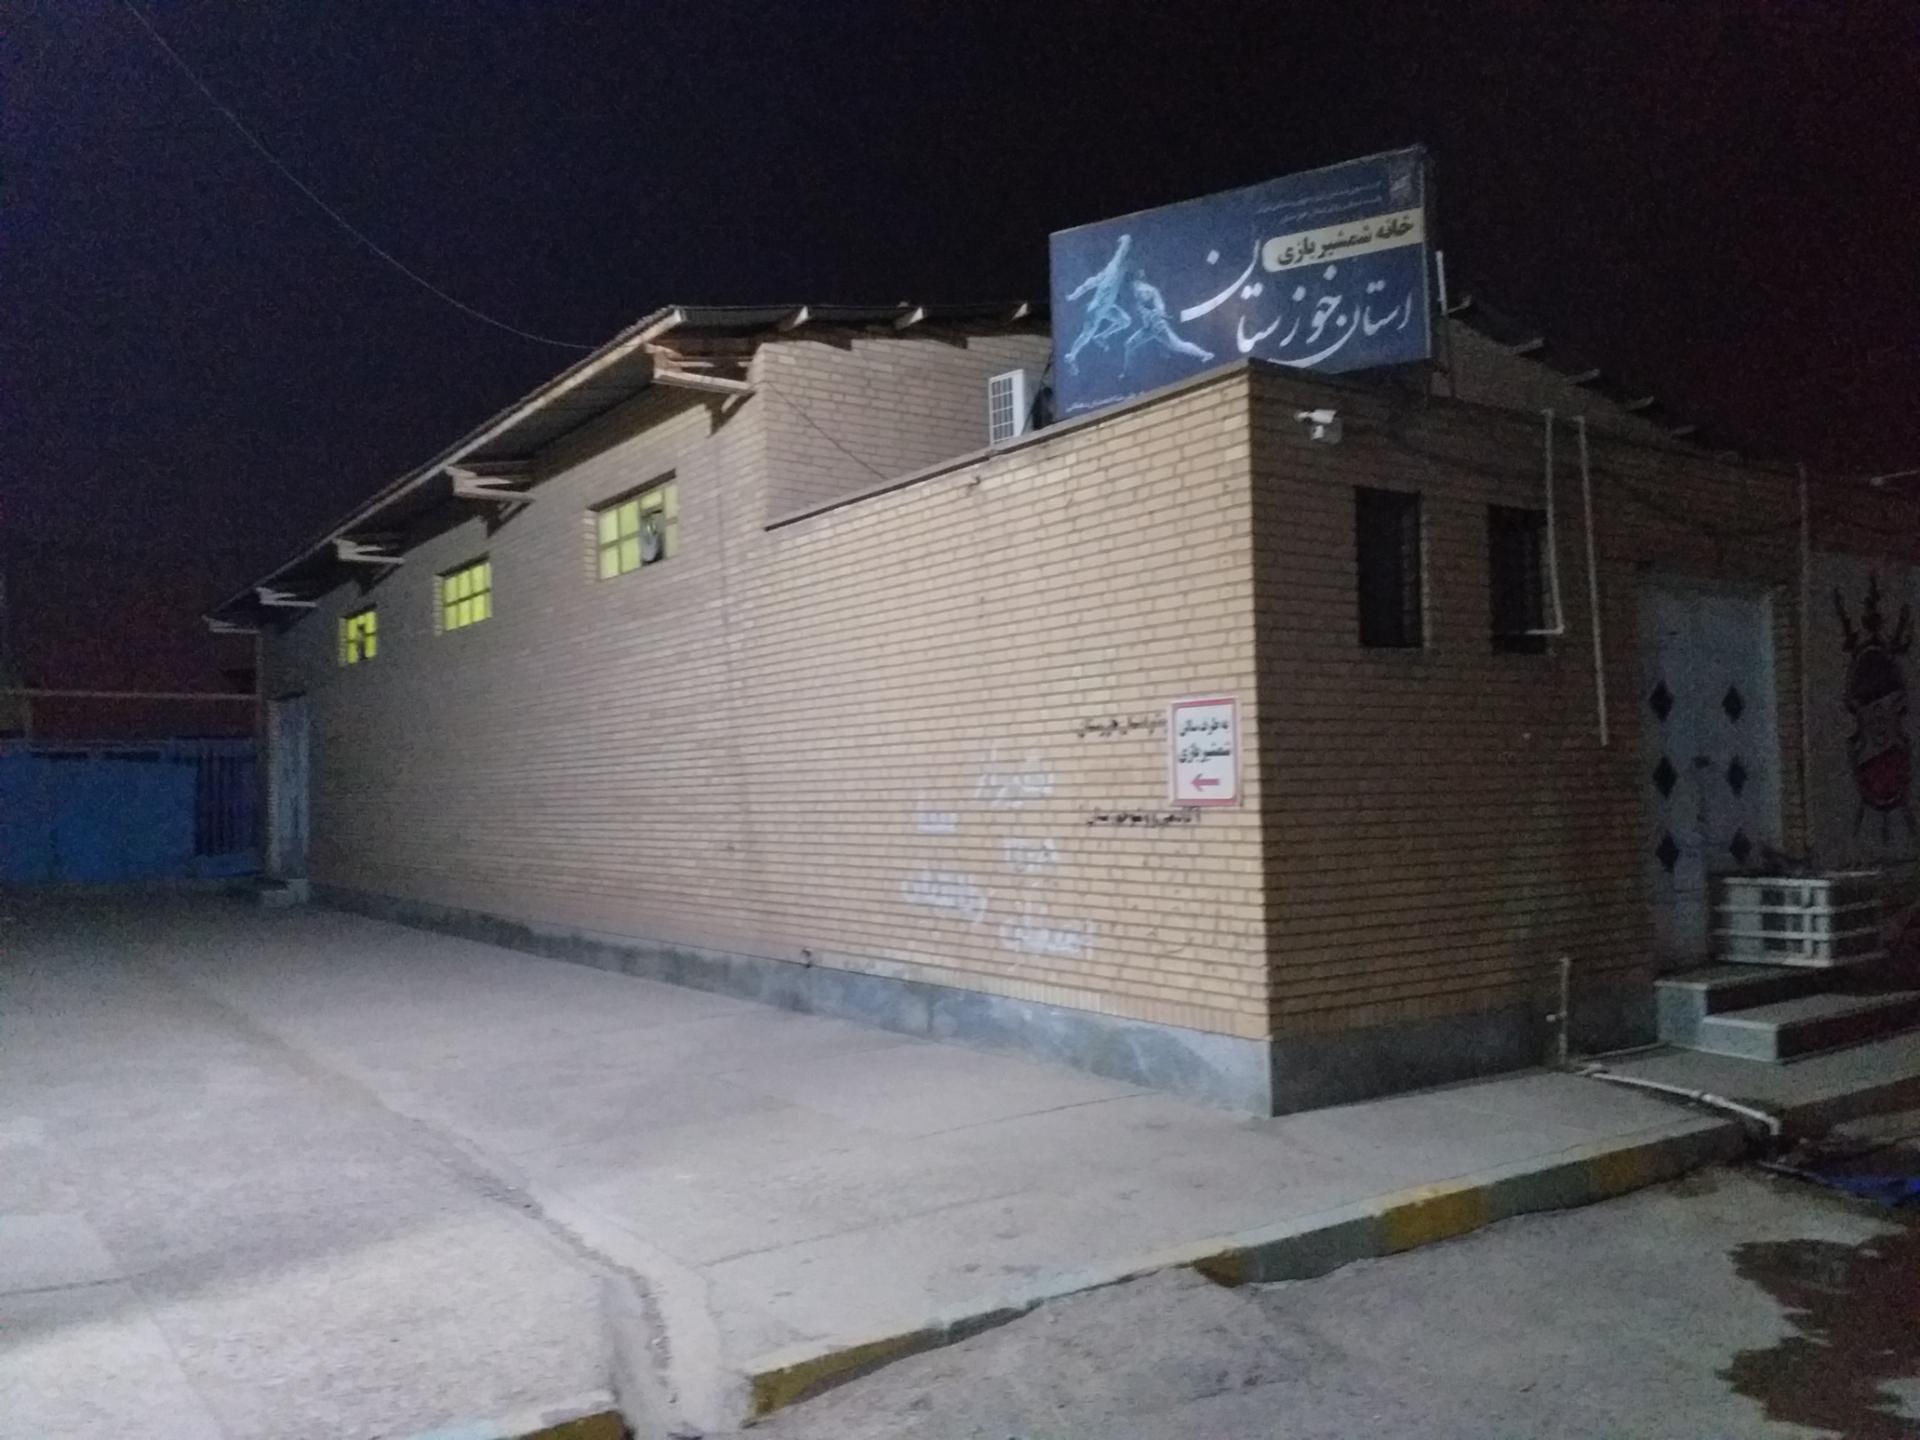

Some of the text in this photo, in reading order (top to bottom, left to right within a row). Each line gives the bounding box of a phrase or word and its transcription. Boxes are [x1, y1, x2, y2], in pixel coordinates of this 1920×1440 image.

[1376, 212, 1415, 239] خانه
[1179, 239, 1413, 369] استان خوزستان
